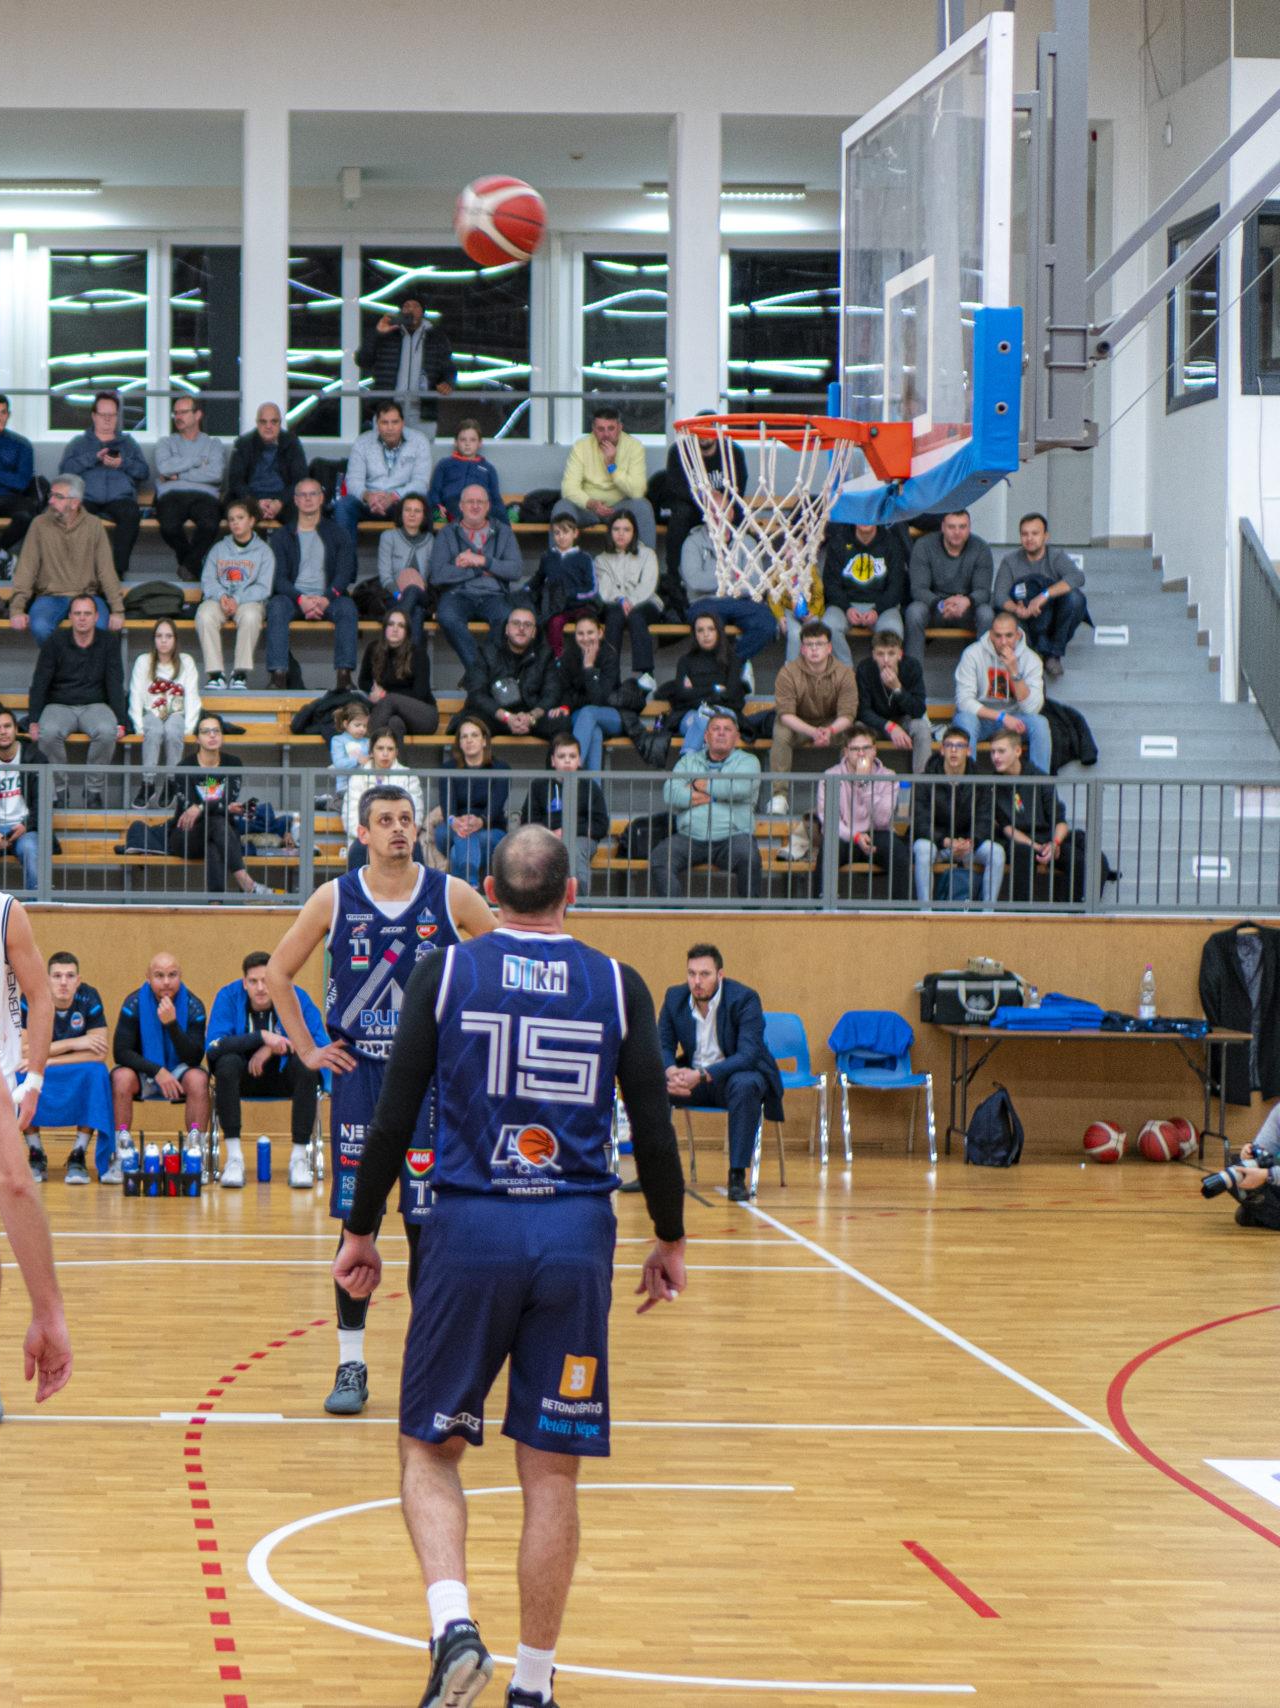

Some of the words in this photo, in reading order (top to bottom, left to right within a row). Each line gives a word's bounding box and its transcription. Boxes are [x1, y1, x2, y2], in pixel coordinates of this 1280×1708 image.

[349, 938, 371, 955] 11
[461, 1011, 604, 1106] 15
[411, 1152, 431, 1163] MOL
[507, 1186, 554, 1196] NEMZETI
[574, 1421, 600, 1438] Népe
